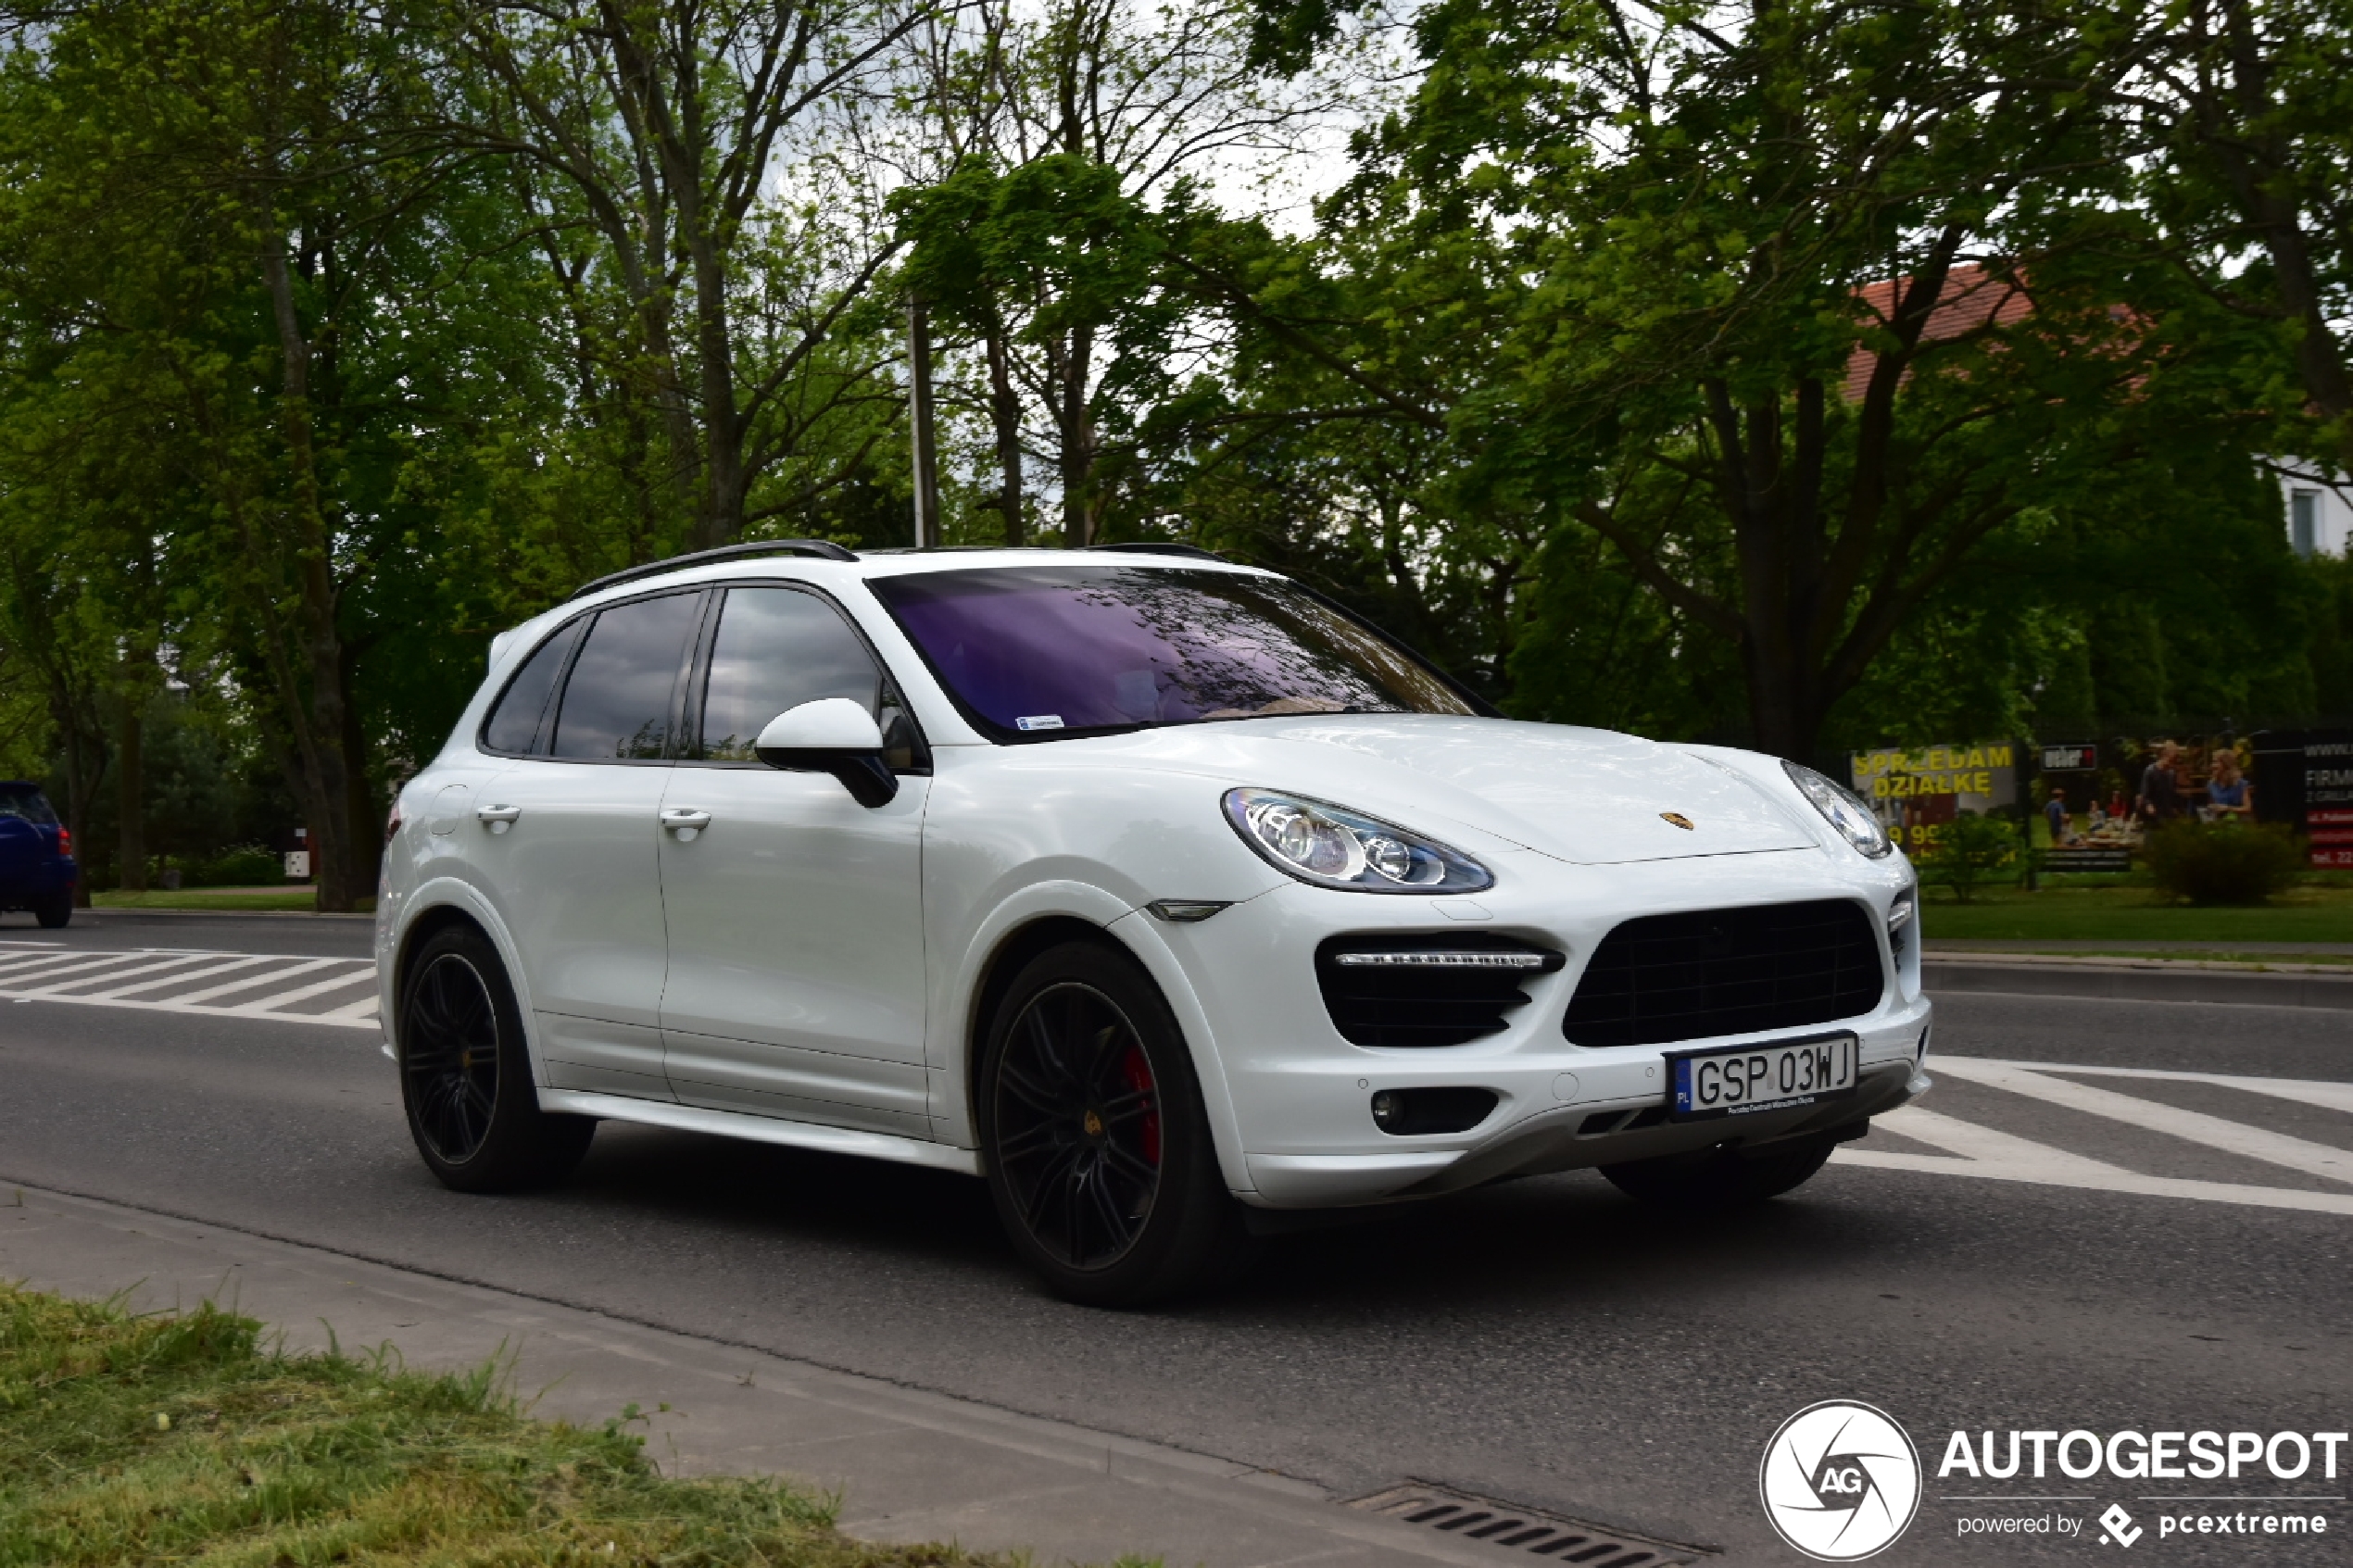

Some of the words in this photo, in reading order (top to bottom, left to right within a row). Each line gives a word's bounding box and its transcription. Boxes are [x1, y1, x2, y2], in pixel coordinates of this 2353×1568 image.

[1854, 746, 2014, 775] SPRZEDAM
[1873, 771, 1993, 798] DZIAŁKĘ
[1698, 1055, 1768, 1104] GSP
[1780, 1042, 1847, 1094] 03WJ
[1677, 1092, 1690, 1104] PL
